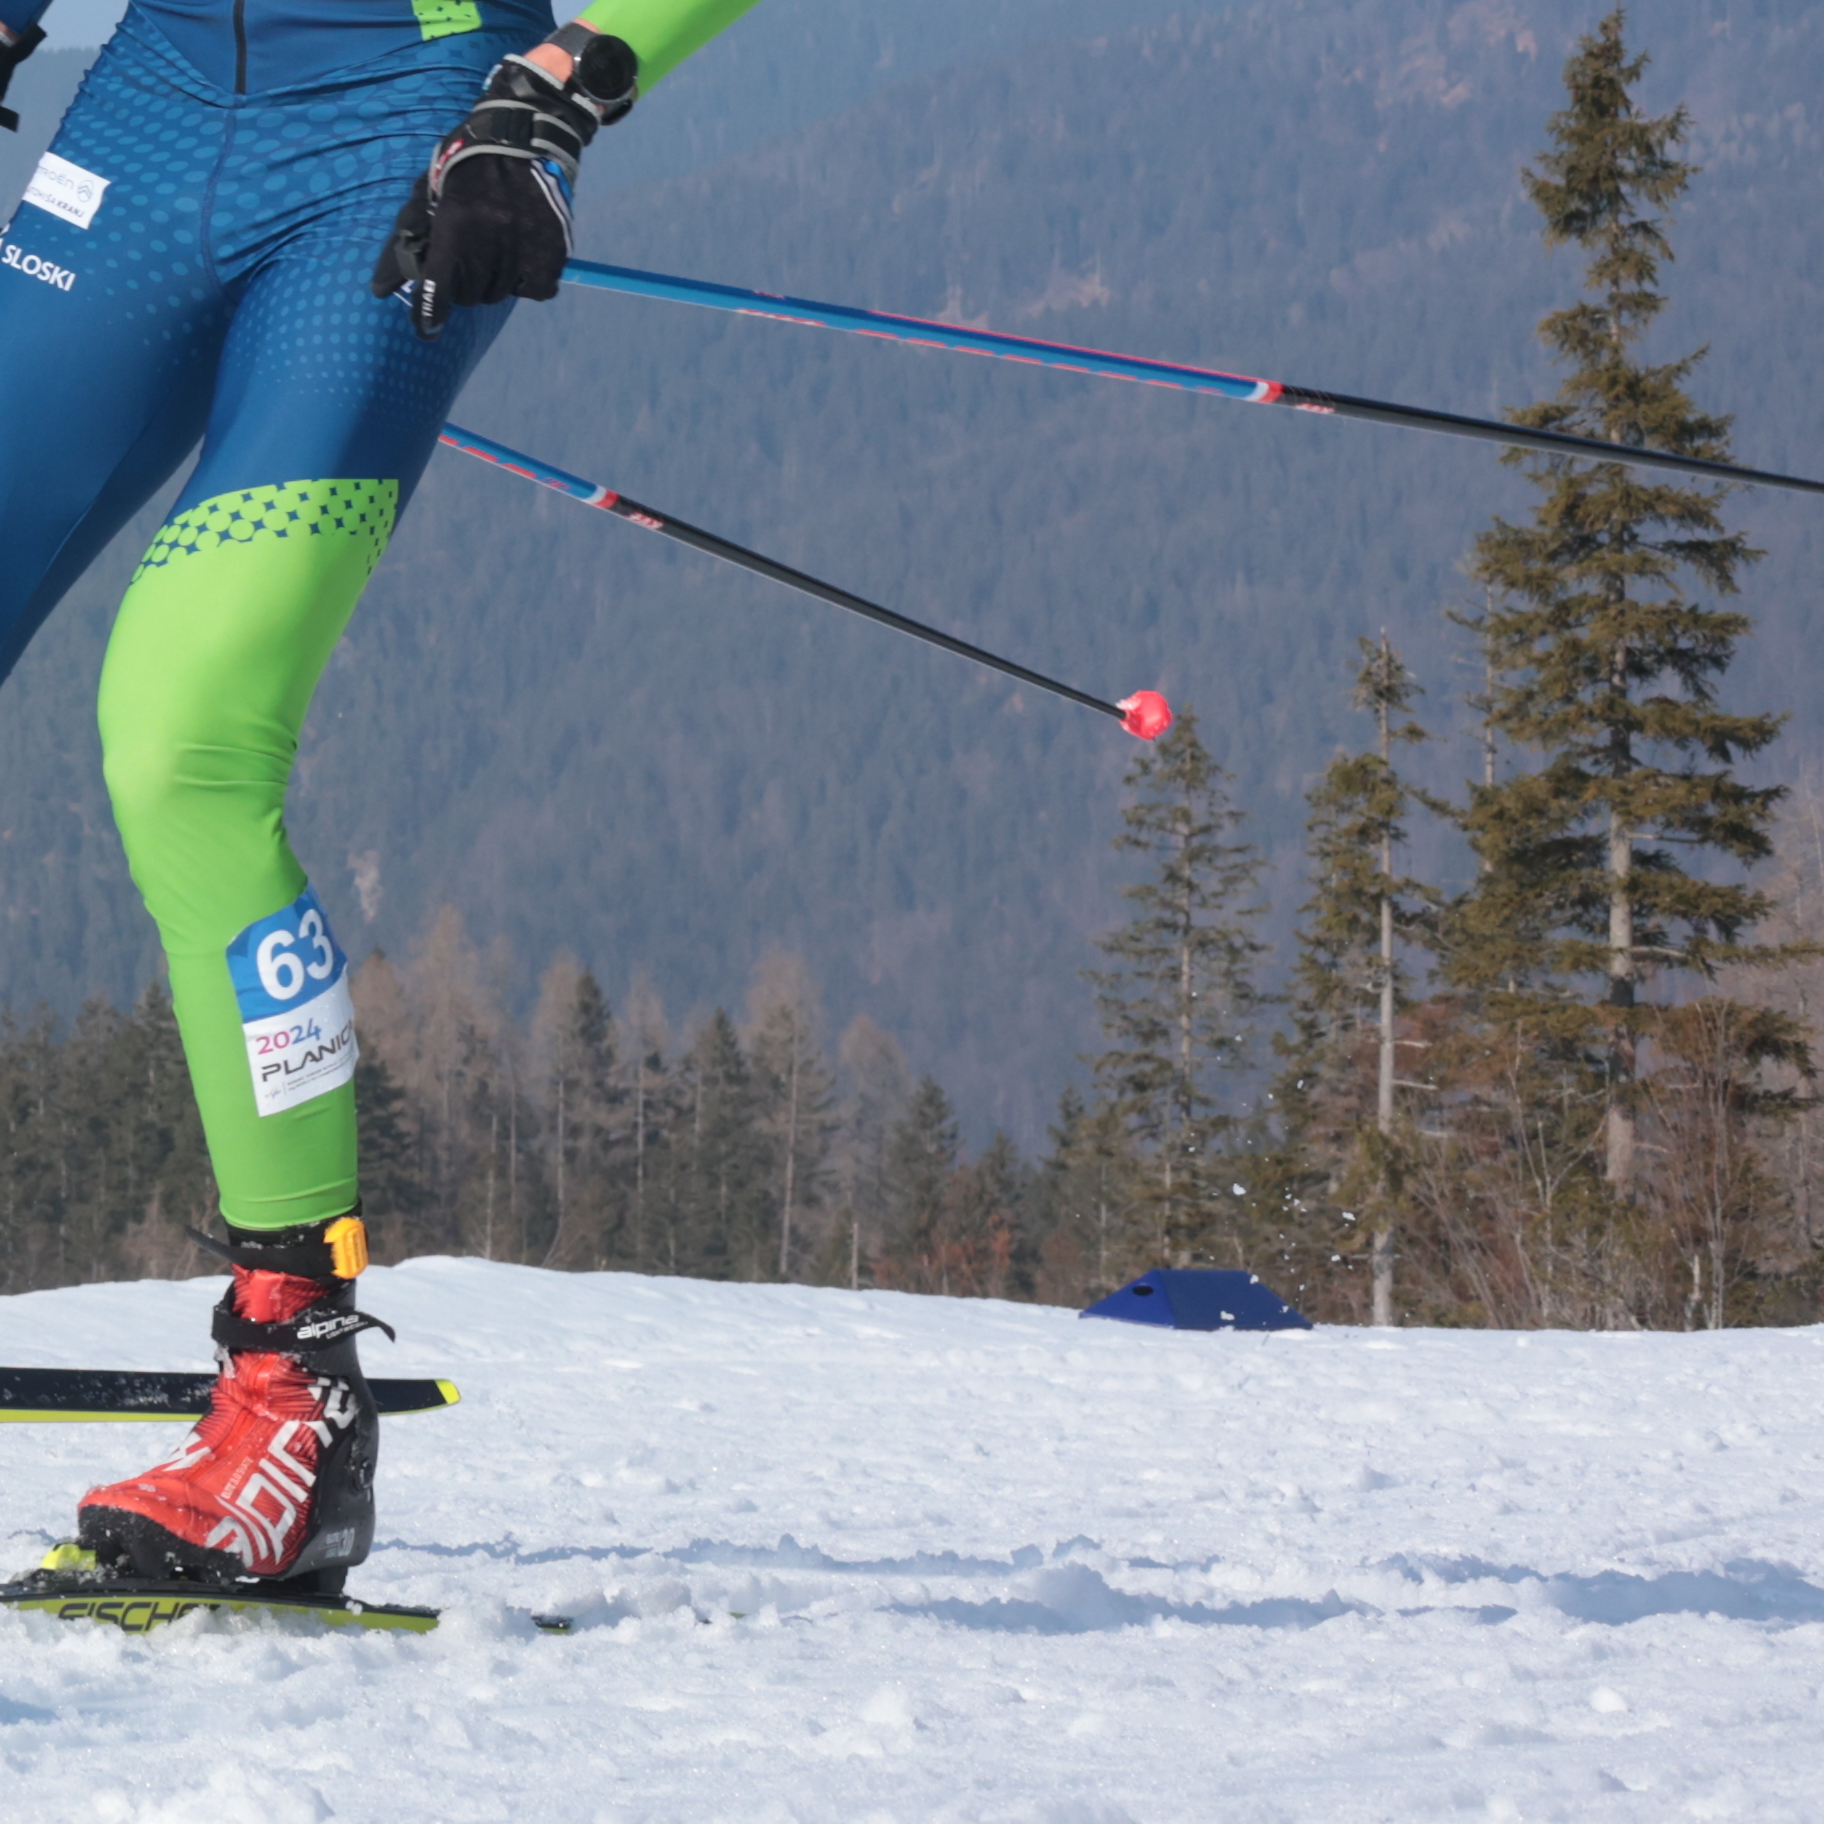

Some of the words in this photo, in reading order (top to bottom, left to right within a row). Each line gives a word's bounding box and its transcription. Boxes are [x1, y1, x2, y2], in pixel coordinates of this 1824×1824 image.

[2, 244, 76, 292] SLOSKI
[256, 908, 334, 1001] 63
[255, 1017, 322, 1056] 2024
[261, 1018, 352, 1082] PLANIC
[297, 1314, 360, 1340] alpina
